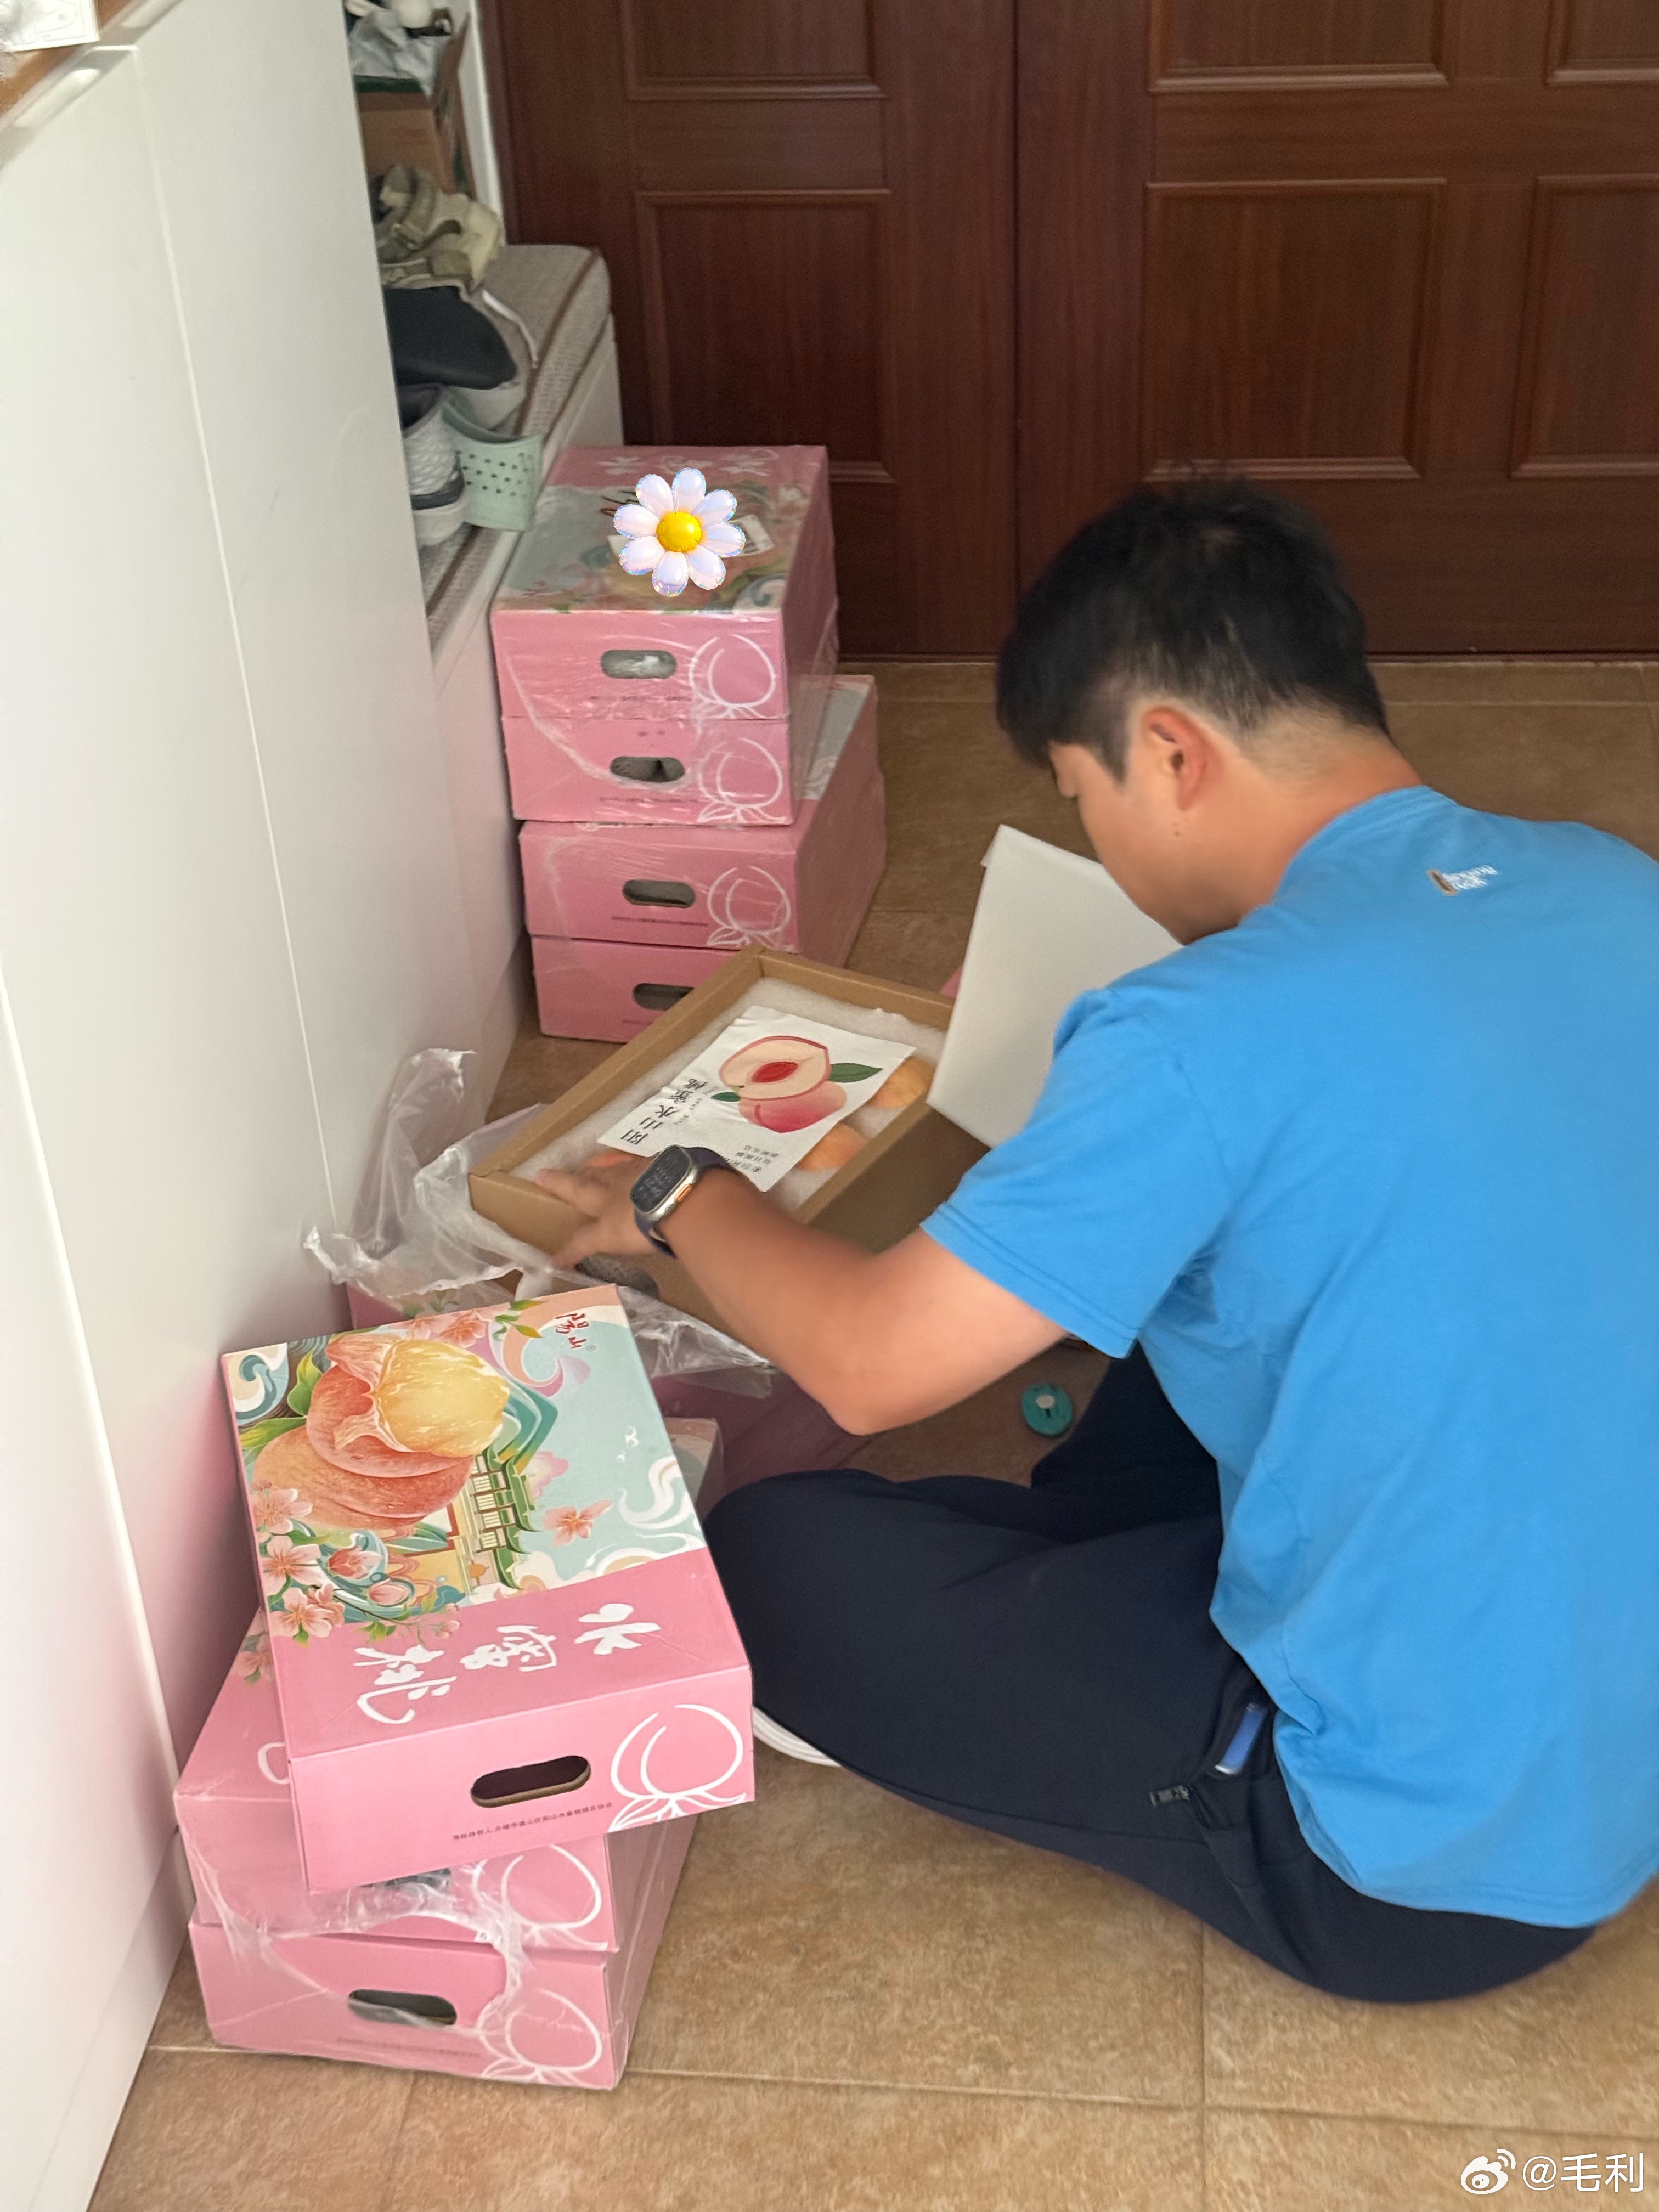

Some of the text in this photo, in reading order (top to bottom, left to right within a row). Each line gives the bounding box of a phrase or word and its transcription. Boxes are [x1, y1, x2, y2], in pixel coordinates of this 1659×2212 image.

[619, 1078, 708, 1146] 阳山水蜜桃
[353, 1602, 662, 1725] 水蜜桃
